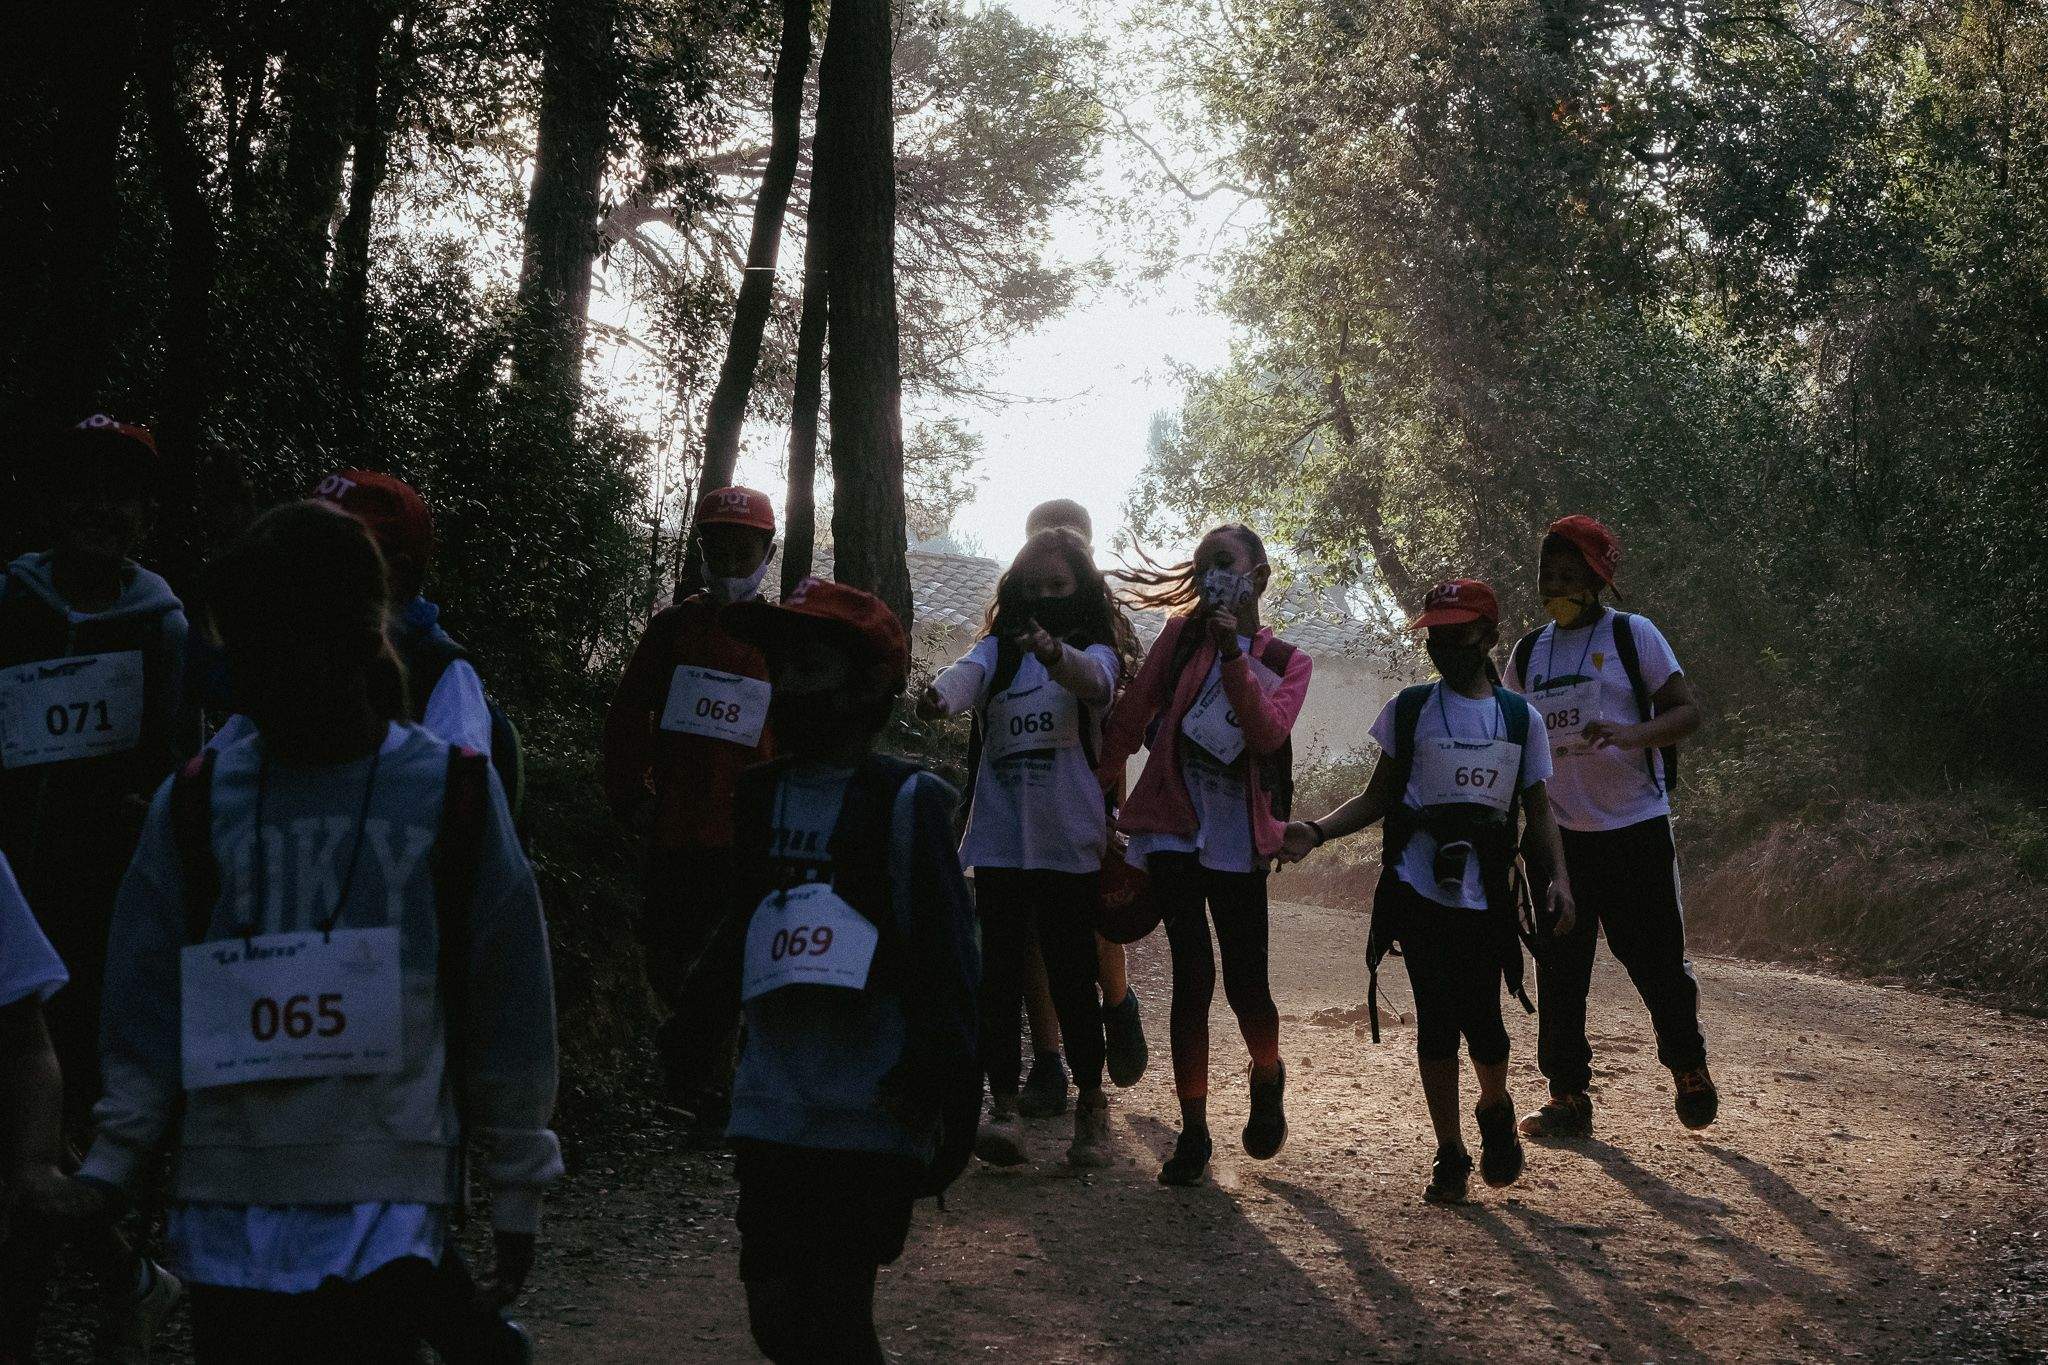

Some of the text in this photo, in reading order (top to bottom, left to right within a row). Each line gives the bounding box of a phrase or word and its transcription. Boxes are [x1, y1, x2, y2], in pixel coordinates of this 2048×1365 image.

[316, 473, 357, 498] OT
[46, 700, 112, 735] 071
[695, 697, 741, 723] 068
[1546, 708, 1580, 730] 083
[1009, 711, 1054, 736] 068
[1455, 766, 1499, 788] 667
[771, 926, 833, 962] 069
[251, 993, 346, 1042] 065
